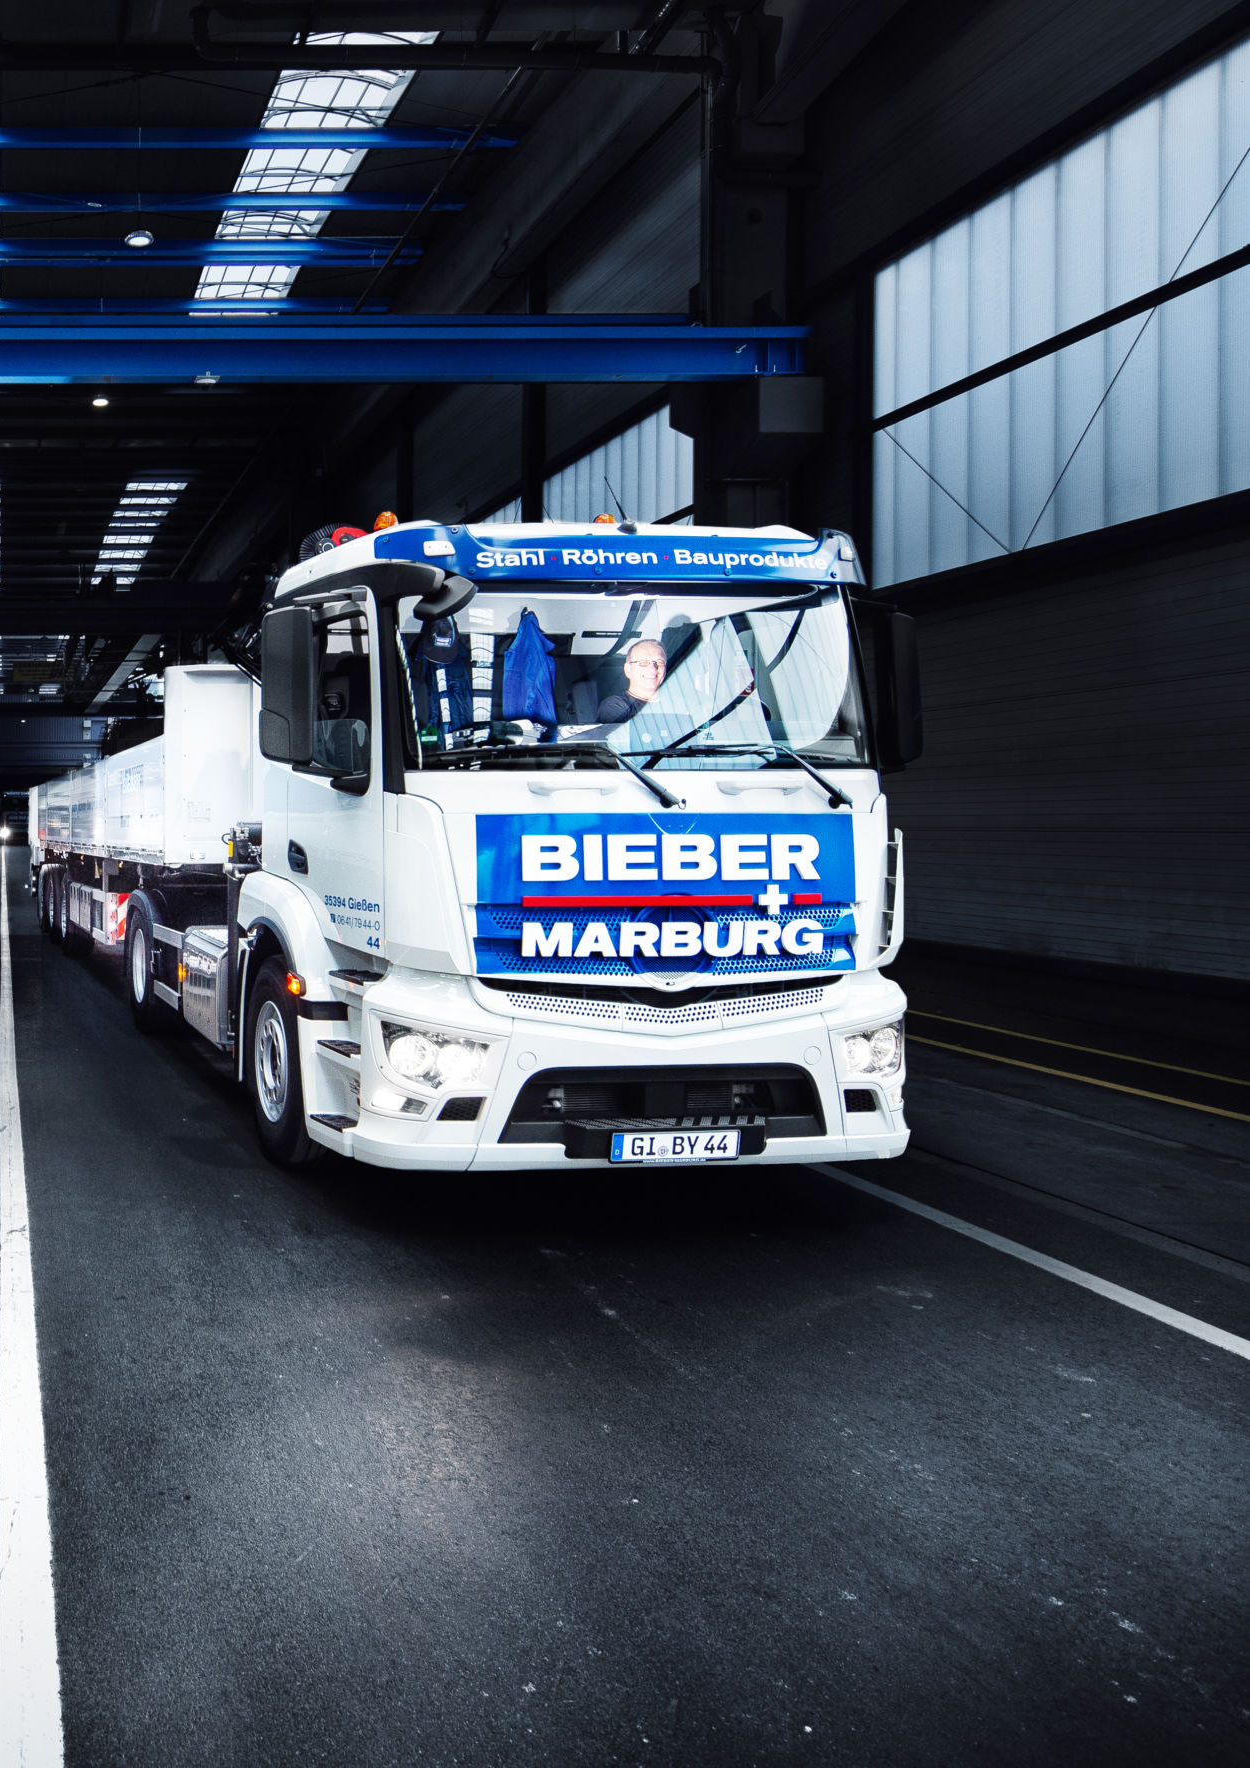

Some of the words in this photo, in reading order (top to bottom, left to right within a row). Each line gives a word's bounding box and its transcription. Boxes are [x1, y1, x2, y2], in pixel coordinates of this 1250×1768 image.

[476, 548, 545, 569] Stahl
[562, 548, 658, 565] Röhren
[674, 548, 828, 570] Bauprodukte
[521, 833, 821, 882] BIEBER
[324, 894, 346, 908] 35394
[366, 935, 380, 950] 44
[521, 918, 825, 958] MARBURG
[631, 1137, 656, 1156] GI
[672, 1135, 699, 1155] BY
[704, 1134, 728, 1154] 44
